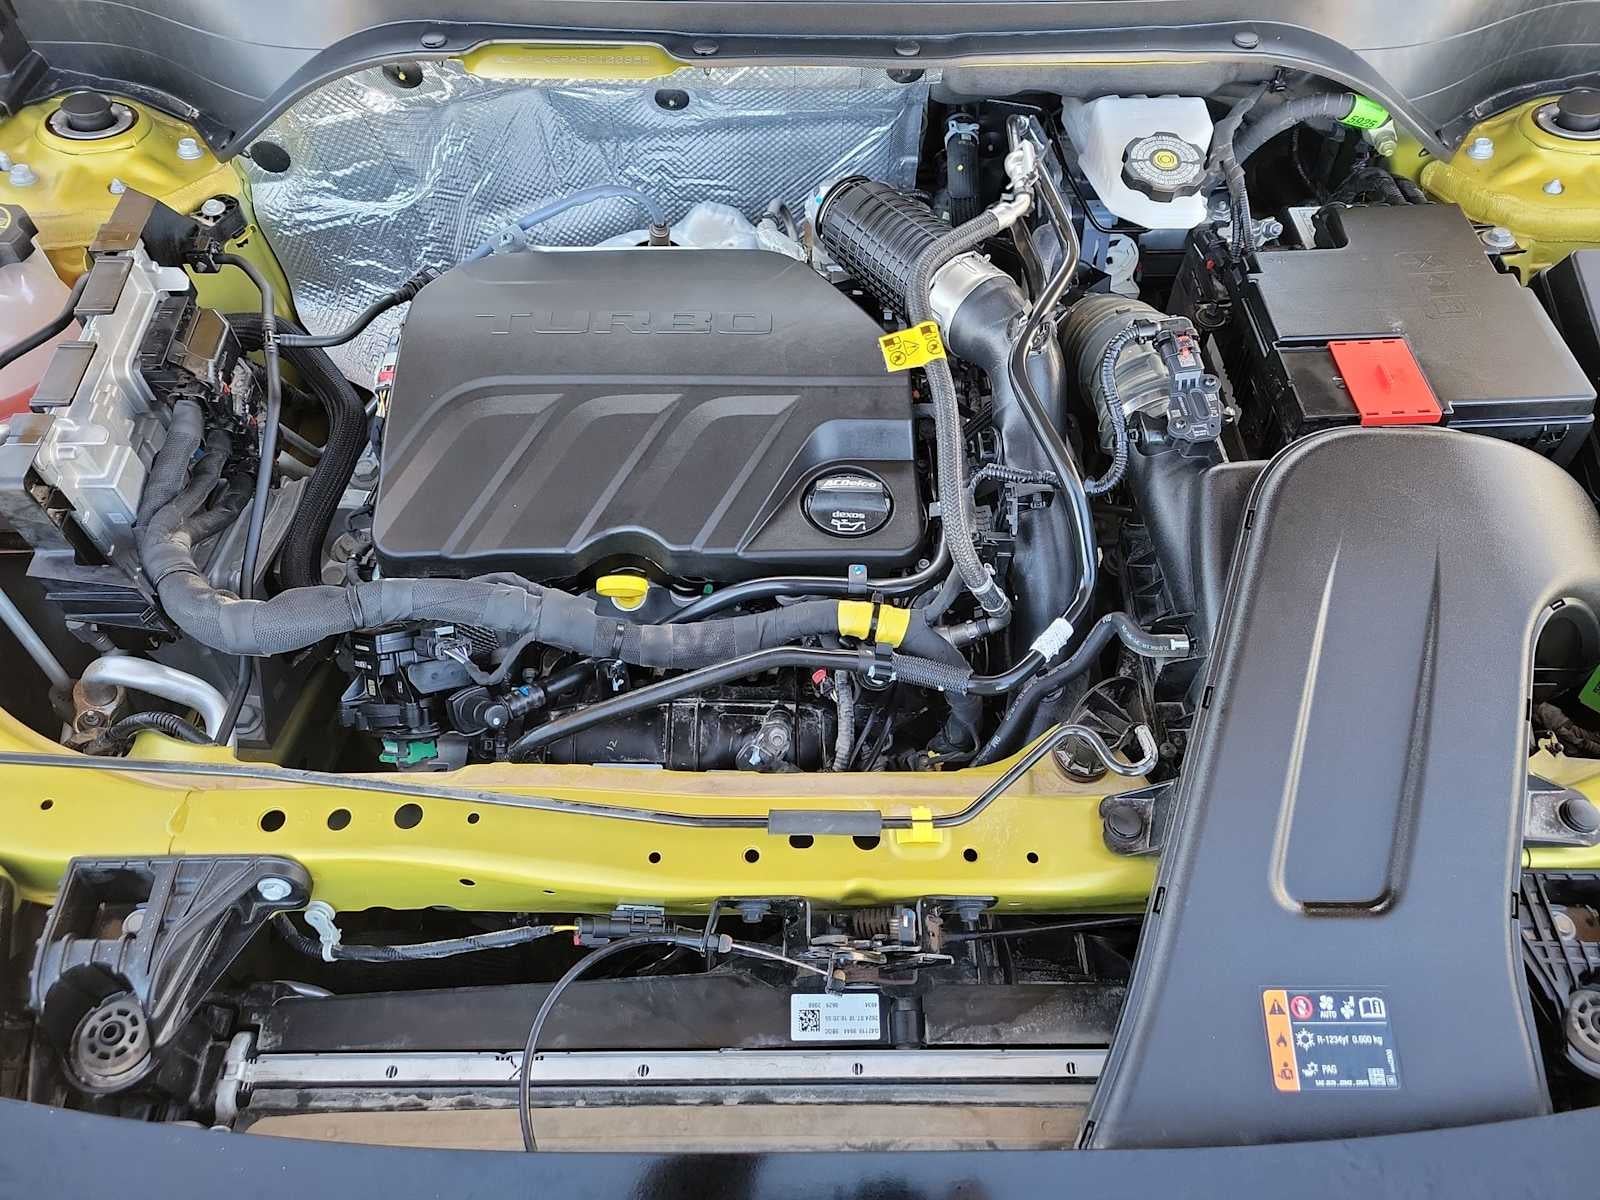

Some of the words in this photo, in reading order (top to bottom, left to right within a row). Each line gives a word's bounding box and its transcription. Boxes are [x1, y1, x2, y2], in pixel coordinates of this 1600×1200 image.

[474, 309, 774, 335] TURBO
[823, 479, 877, 488] ACDelco
[832, 510, 866, 519] dexos
[1320, 1010, 1337, 1019] AUTO
[1321, 1064, 1338, 1075] PAG
